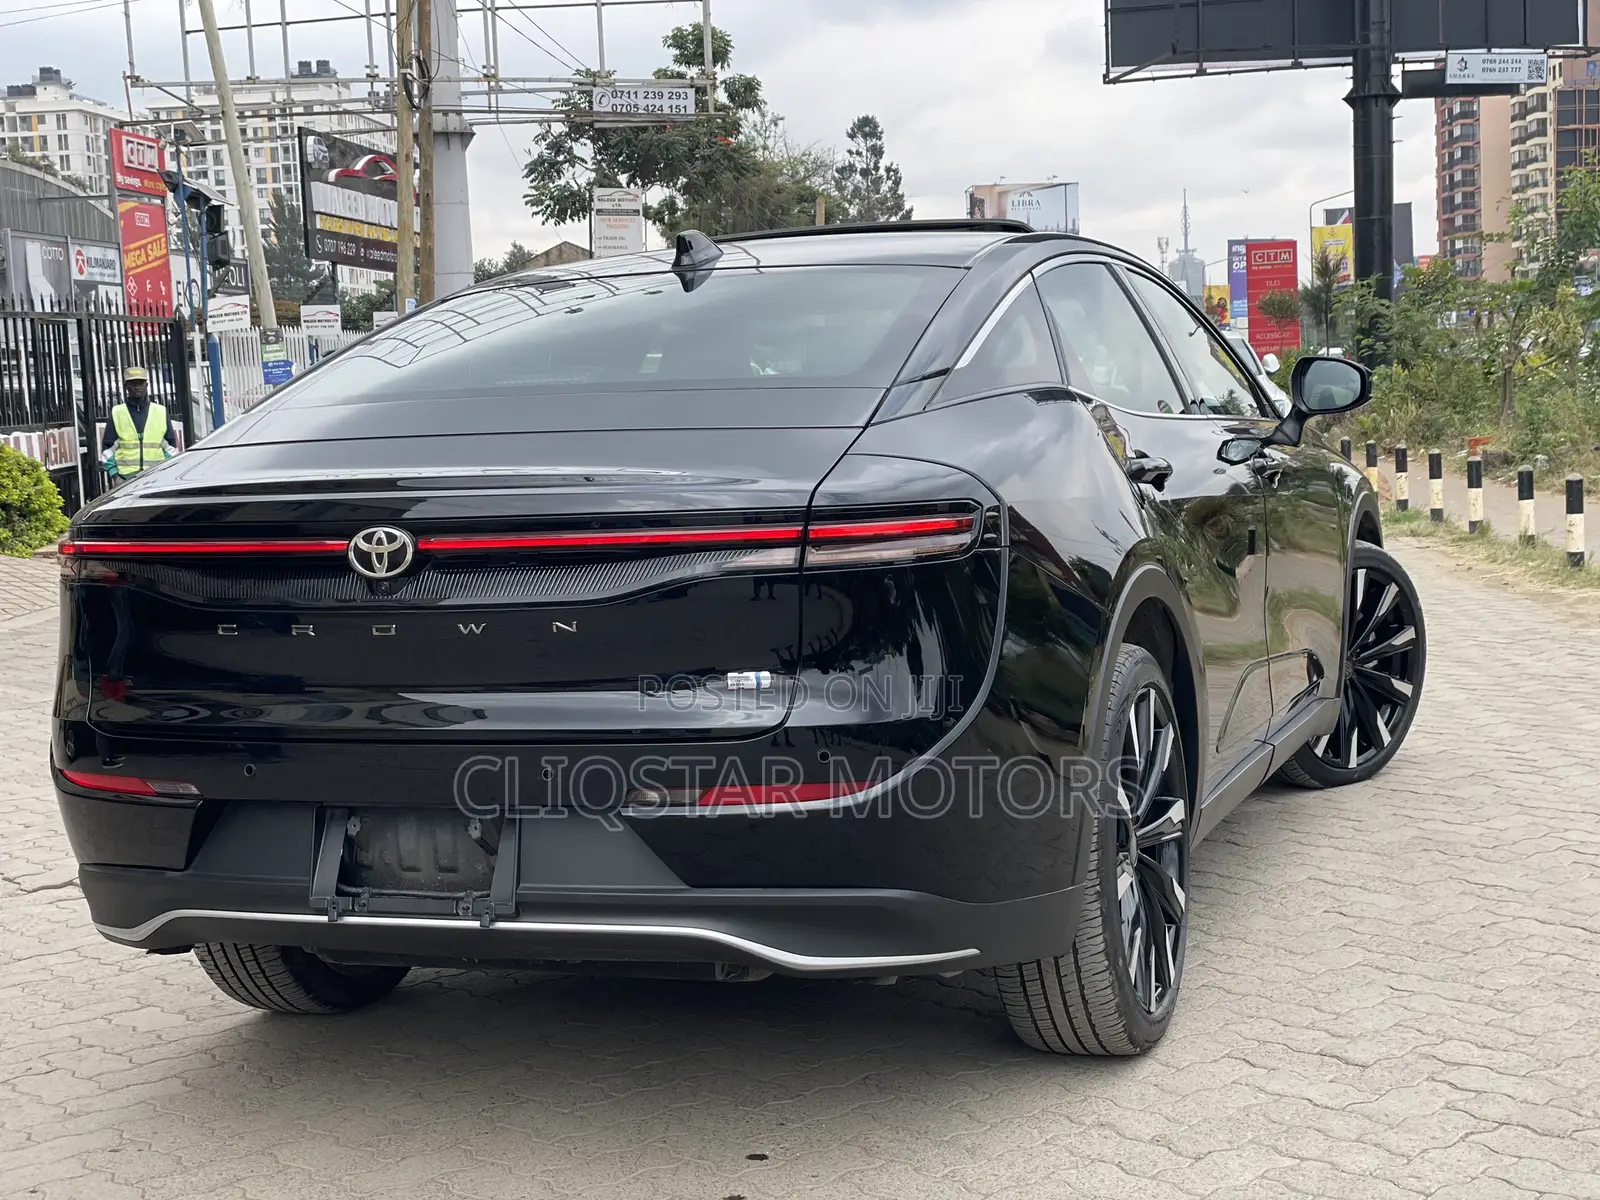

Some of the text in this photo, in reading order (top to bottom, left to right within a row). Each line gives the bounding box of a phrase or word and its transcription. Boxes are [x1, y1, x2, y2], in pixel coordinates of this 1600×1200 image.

[611, 90, 688, 100] 0711 239 293
[611, 104, 687, 114] 0705 424 151
[1011, 199, 1041, 207] LIBRA
[124, 238, 167, 270] MEGA SALE
[1255, 251, 1290, 262] CTM
[217, 619, 578, 637] CROWN
